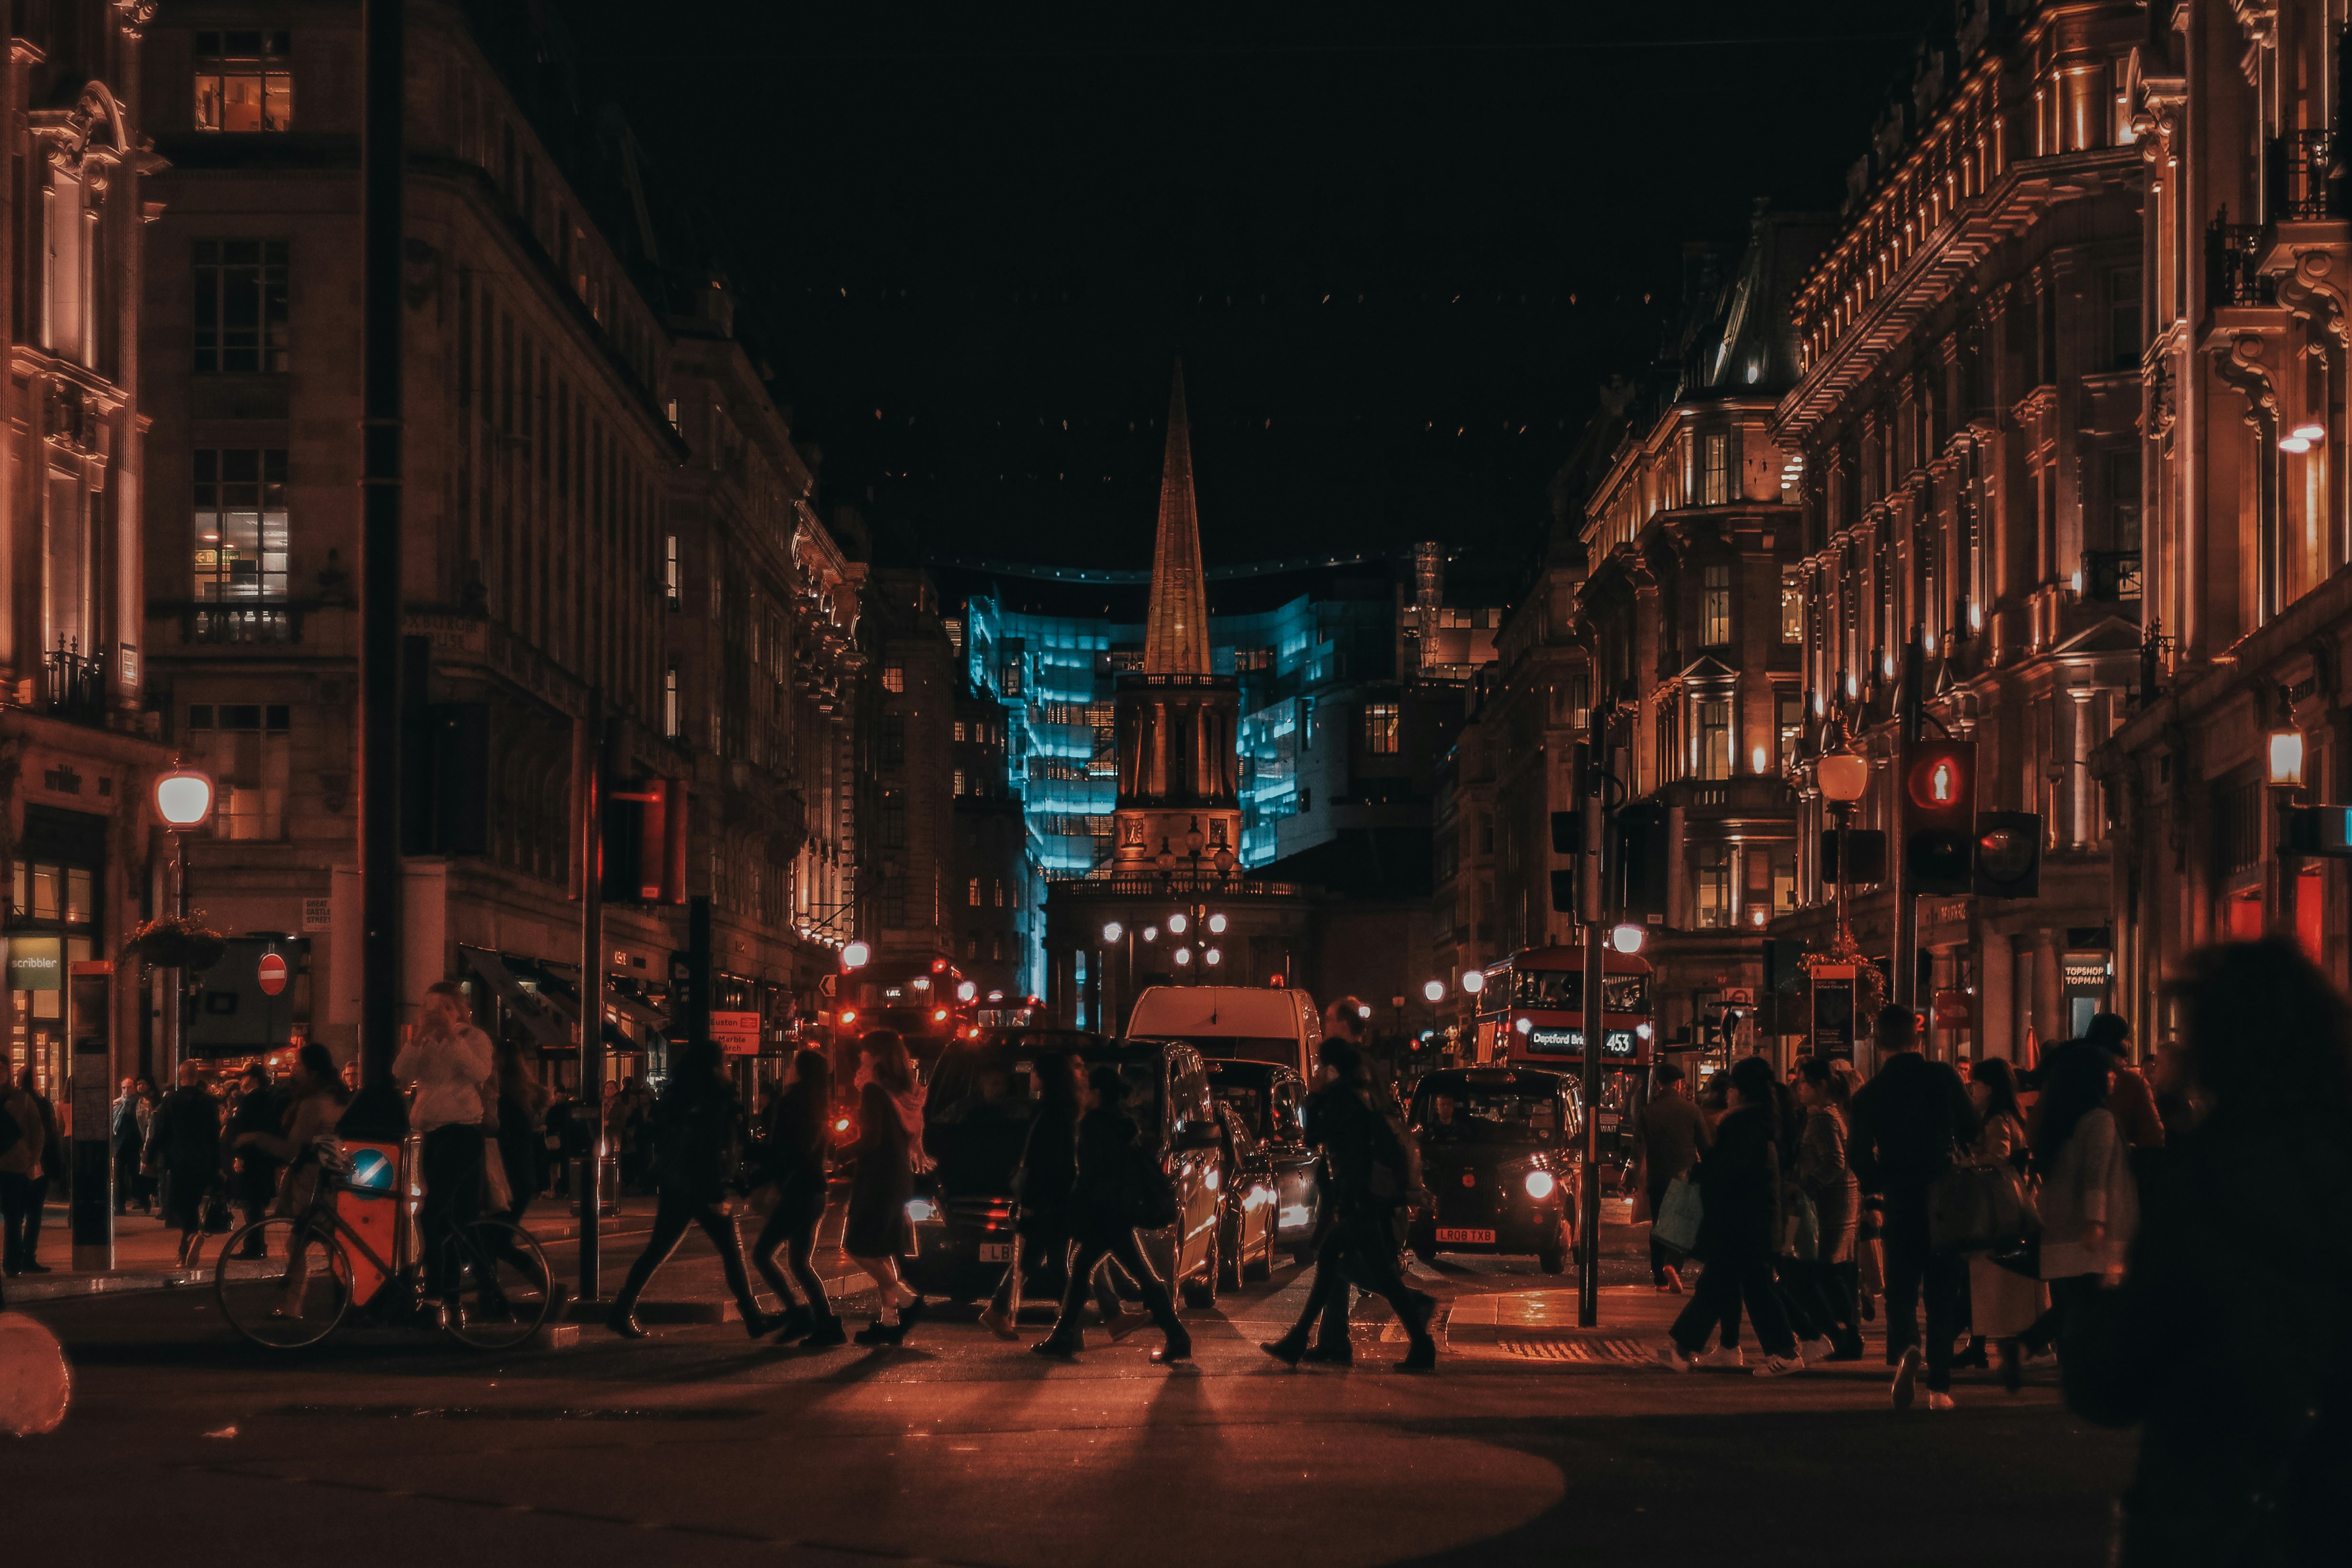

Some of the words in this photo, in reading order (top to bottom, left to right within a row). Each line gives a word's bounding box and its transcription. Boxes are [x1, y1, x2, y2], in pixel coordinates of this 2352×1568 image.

[408, 632, 464, 649] OUSE
[12, 957, 57, 968] scribbler
[2064, 966, 2104, 976] TOPSHOP
[2064, 976, 2104, 985] TOPMAN
[1533, 1032, 1569, 1046] Deptford
[1606, 1033, 1630, 1052] 453
[1441, 1230, 1467, 1241] LR08
[1471, 1231, 1491, 1241] TXB
